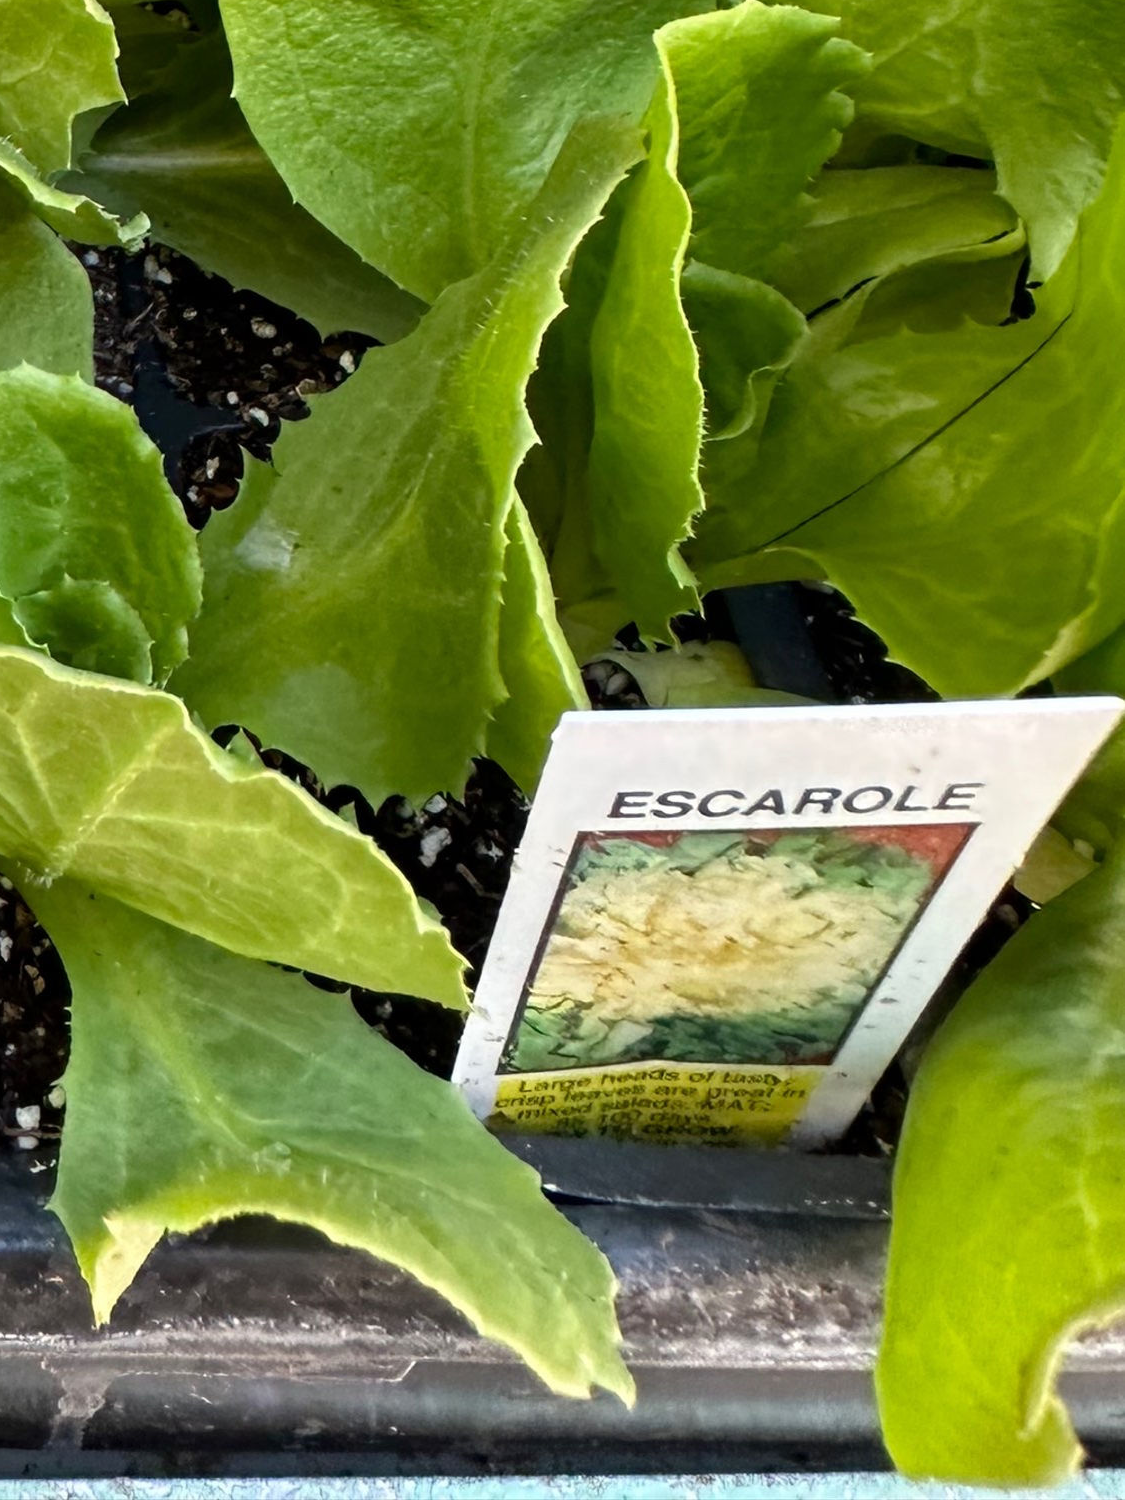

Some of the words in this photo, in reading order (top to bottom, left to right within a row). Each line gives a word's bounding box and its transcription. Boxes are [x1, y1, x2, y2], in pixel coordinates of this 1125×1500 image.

[607, 782, 986, 819] ESCAROLE
[518, 1078, 592, 1093] Large
[600, 1069, 680, 1085] heads
[689, 1070, 715, 1083] of
[495, 1094, 555, 1109] crisp
